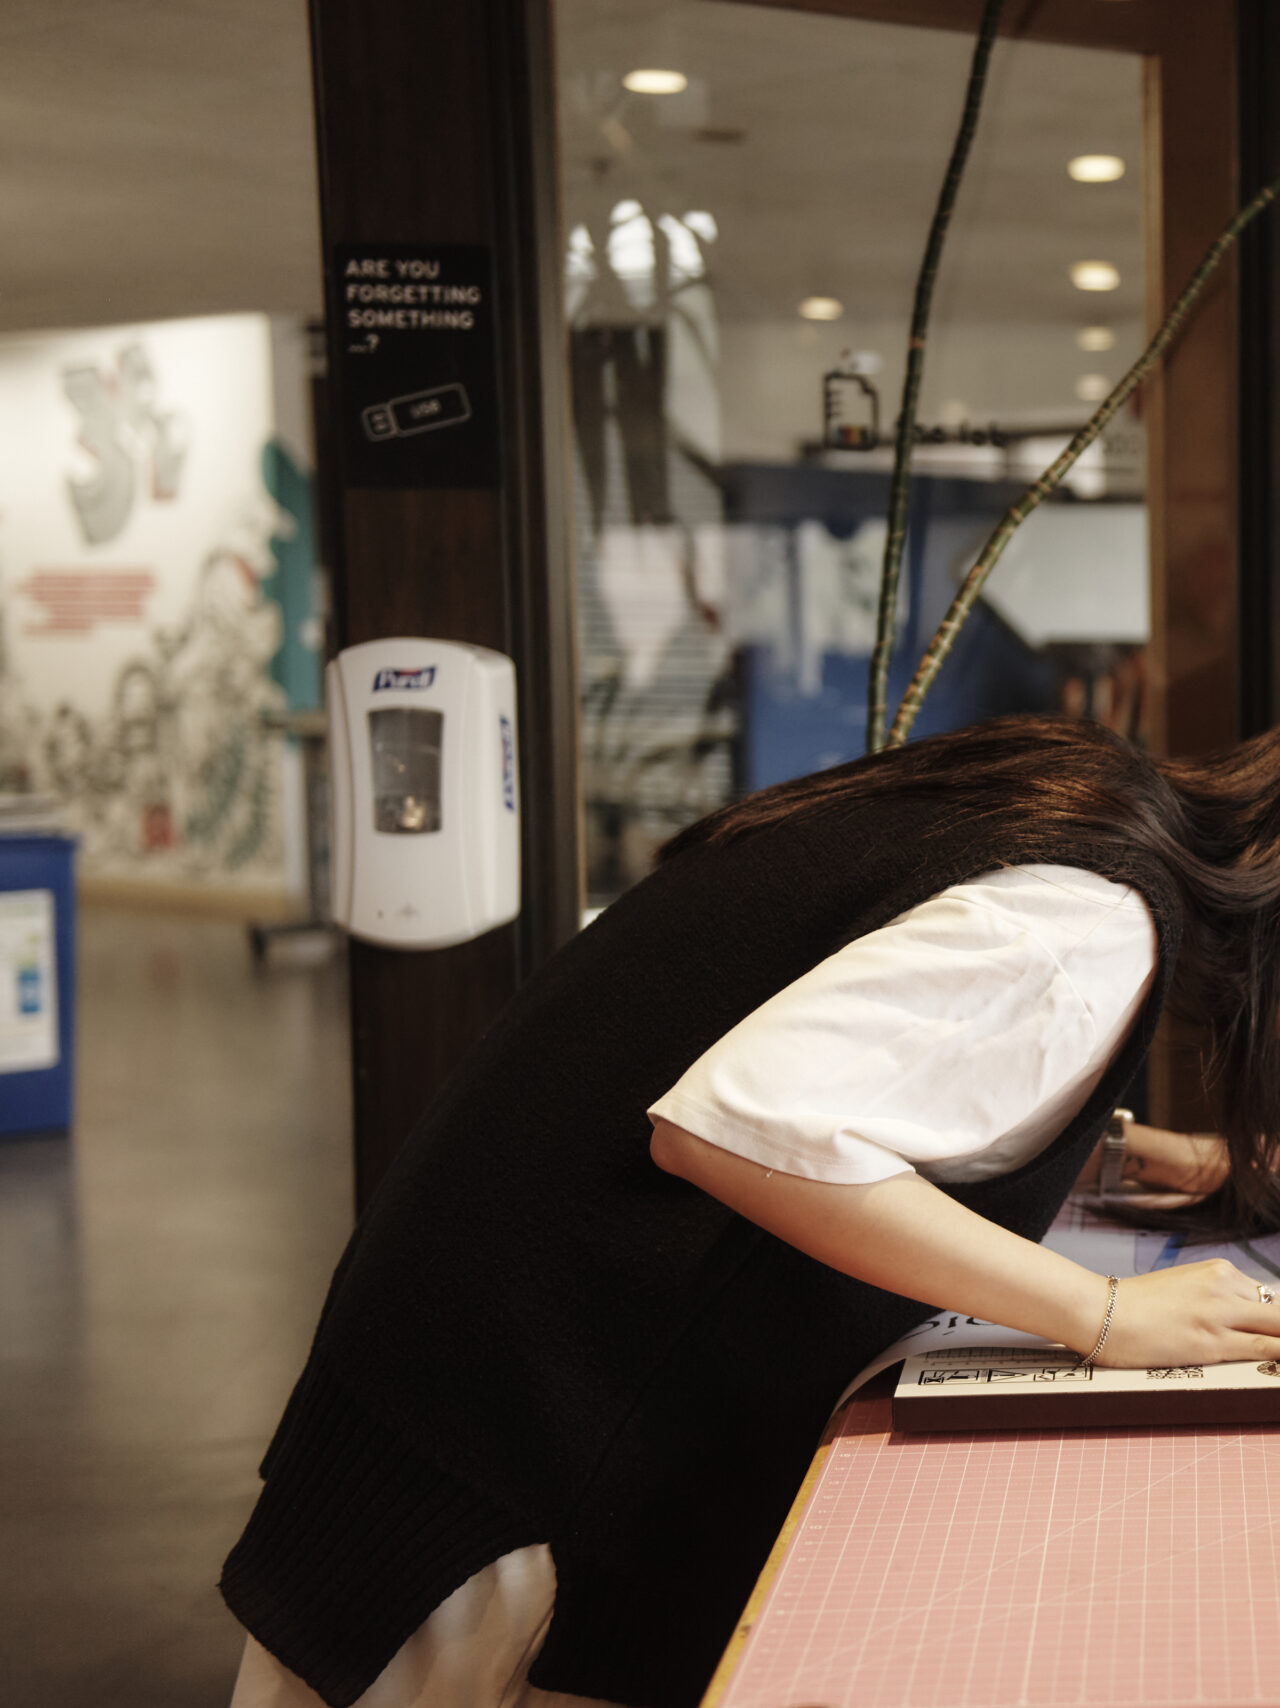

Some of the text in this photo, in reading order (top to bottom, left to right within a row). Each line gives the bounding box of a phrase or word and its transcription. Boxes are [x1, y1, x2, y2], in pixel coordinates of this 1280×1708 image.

[346, 259, 440, 279] ARE YOU
[347, 284, 481, 305] FORGETTING
[349, 309, 475, 330] SOMETHING
